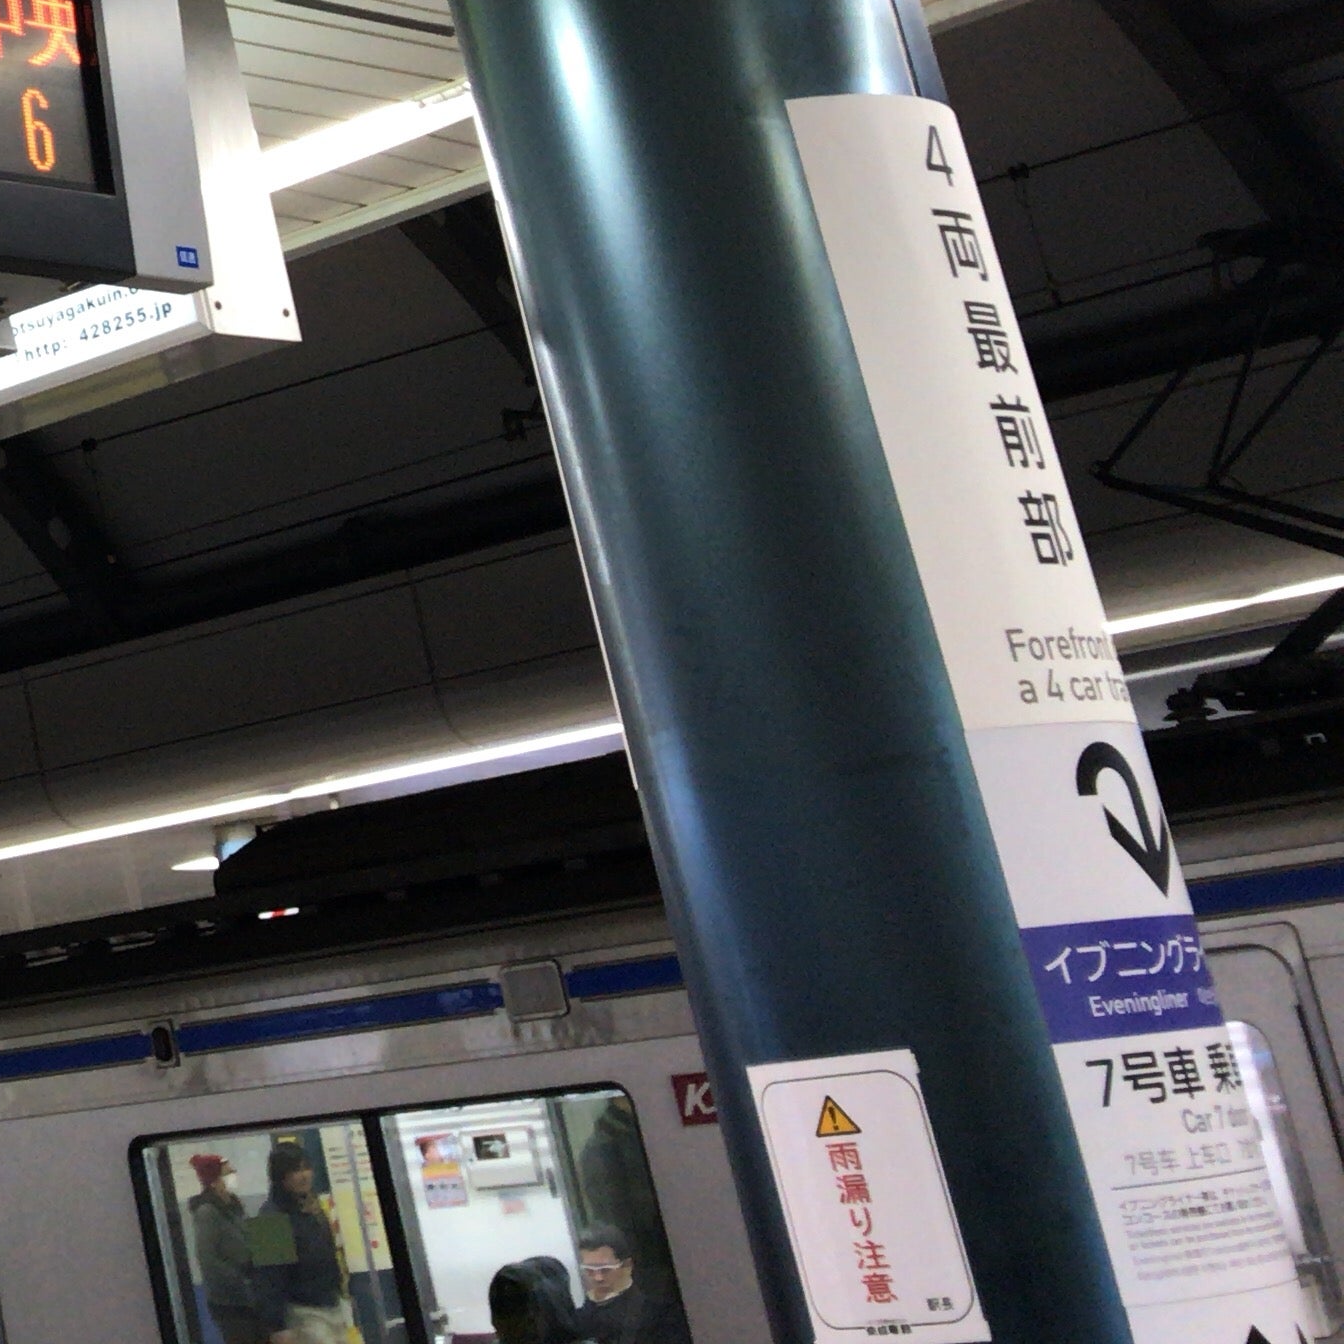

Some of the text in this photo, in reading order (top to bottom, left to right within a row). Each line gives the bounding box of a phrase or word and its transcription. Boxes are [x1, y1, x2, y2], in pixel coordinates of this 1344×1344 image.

[21, 87, 57, 172] 6
[1018, 678, 1040, 704] a
[1047, 668, 1065, 702] 4
[1069, 675, 1104, 701] car
[825, 1142, 898, 1304] 雨漏り注意
